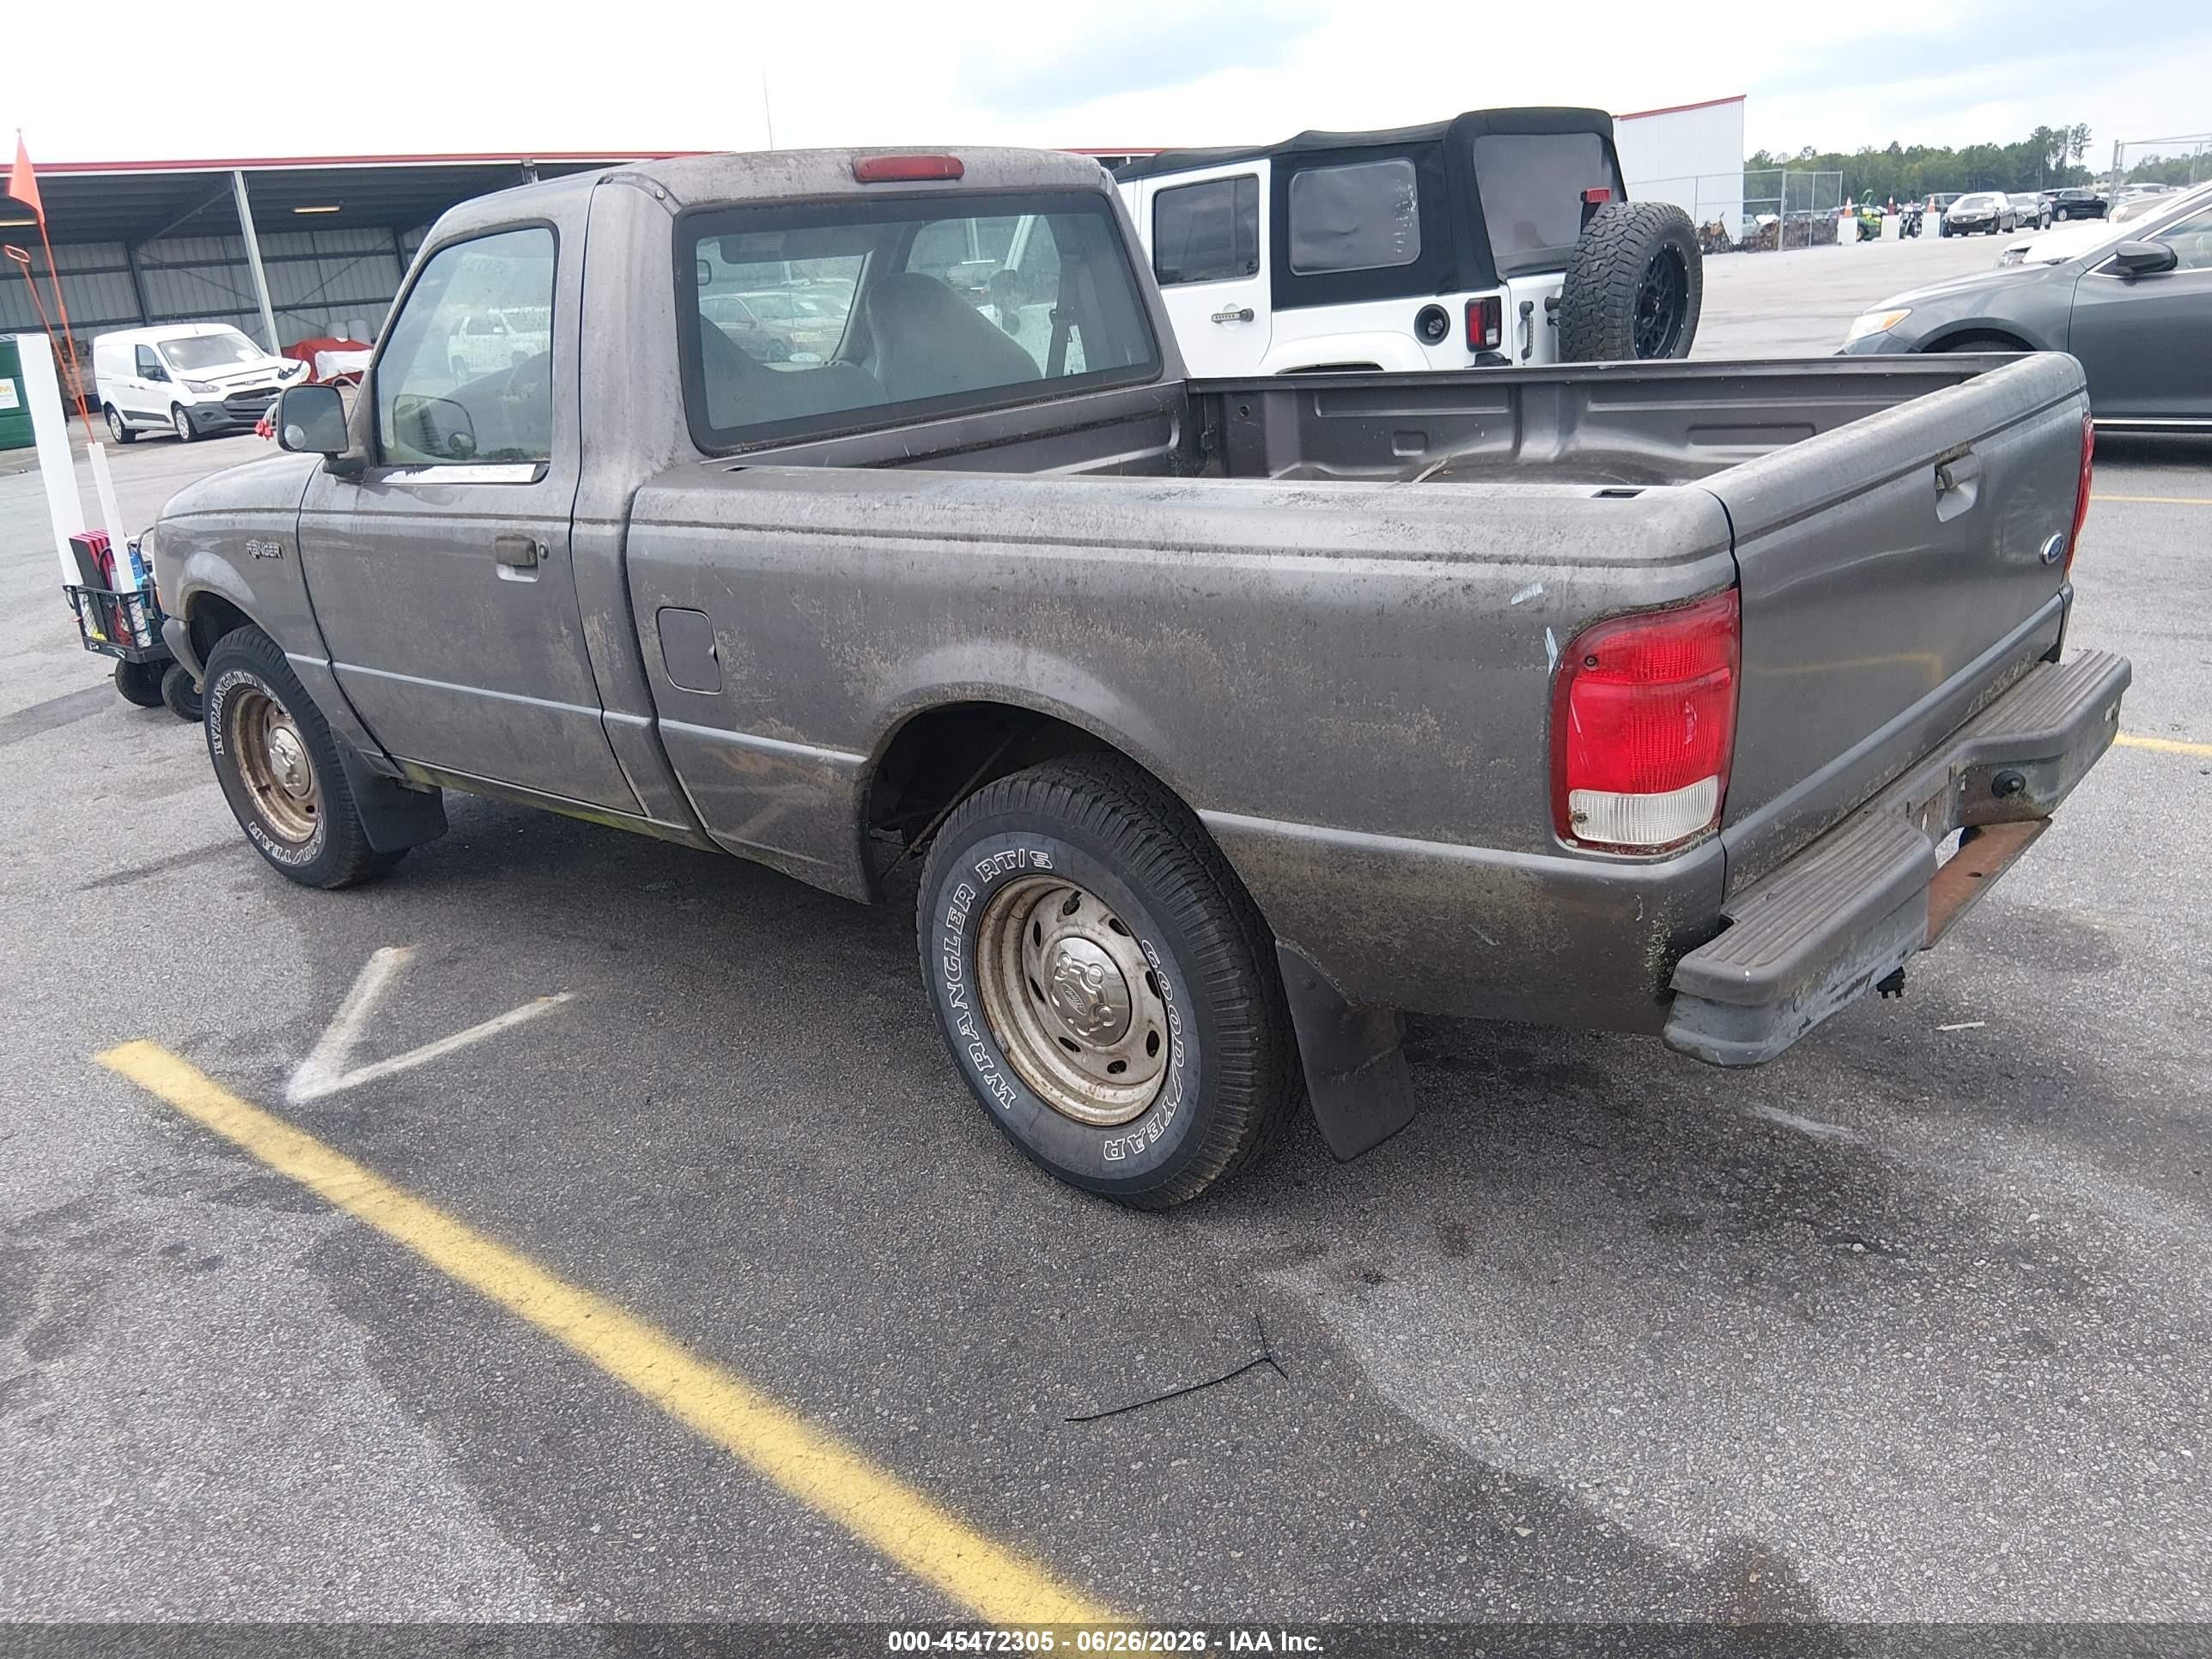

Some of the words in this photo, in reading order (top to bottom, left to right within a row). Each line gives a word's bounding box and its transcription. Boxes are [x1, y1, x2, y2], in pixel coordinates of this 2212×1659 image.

[246, 542, 282, 558] RANGER
[975, 848, 1054, 883] RT/S
[944, 883, 1017, 1109] WRANGLER
[1103, 939, 1185, 1161] GOODYEAR
